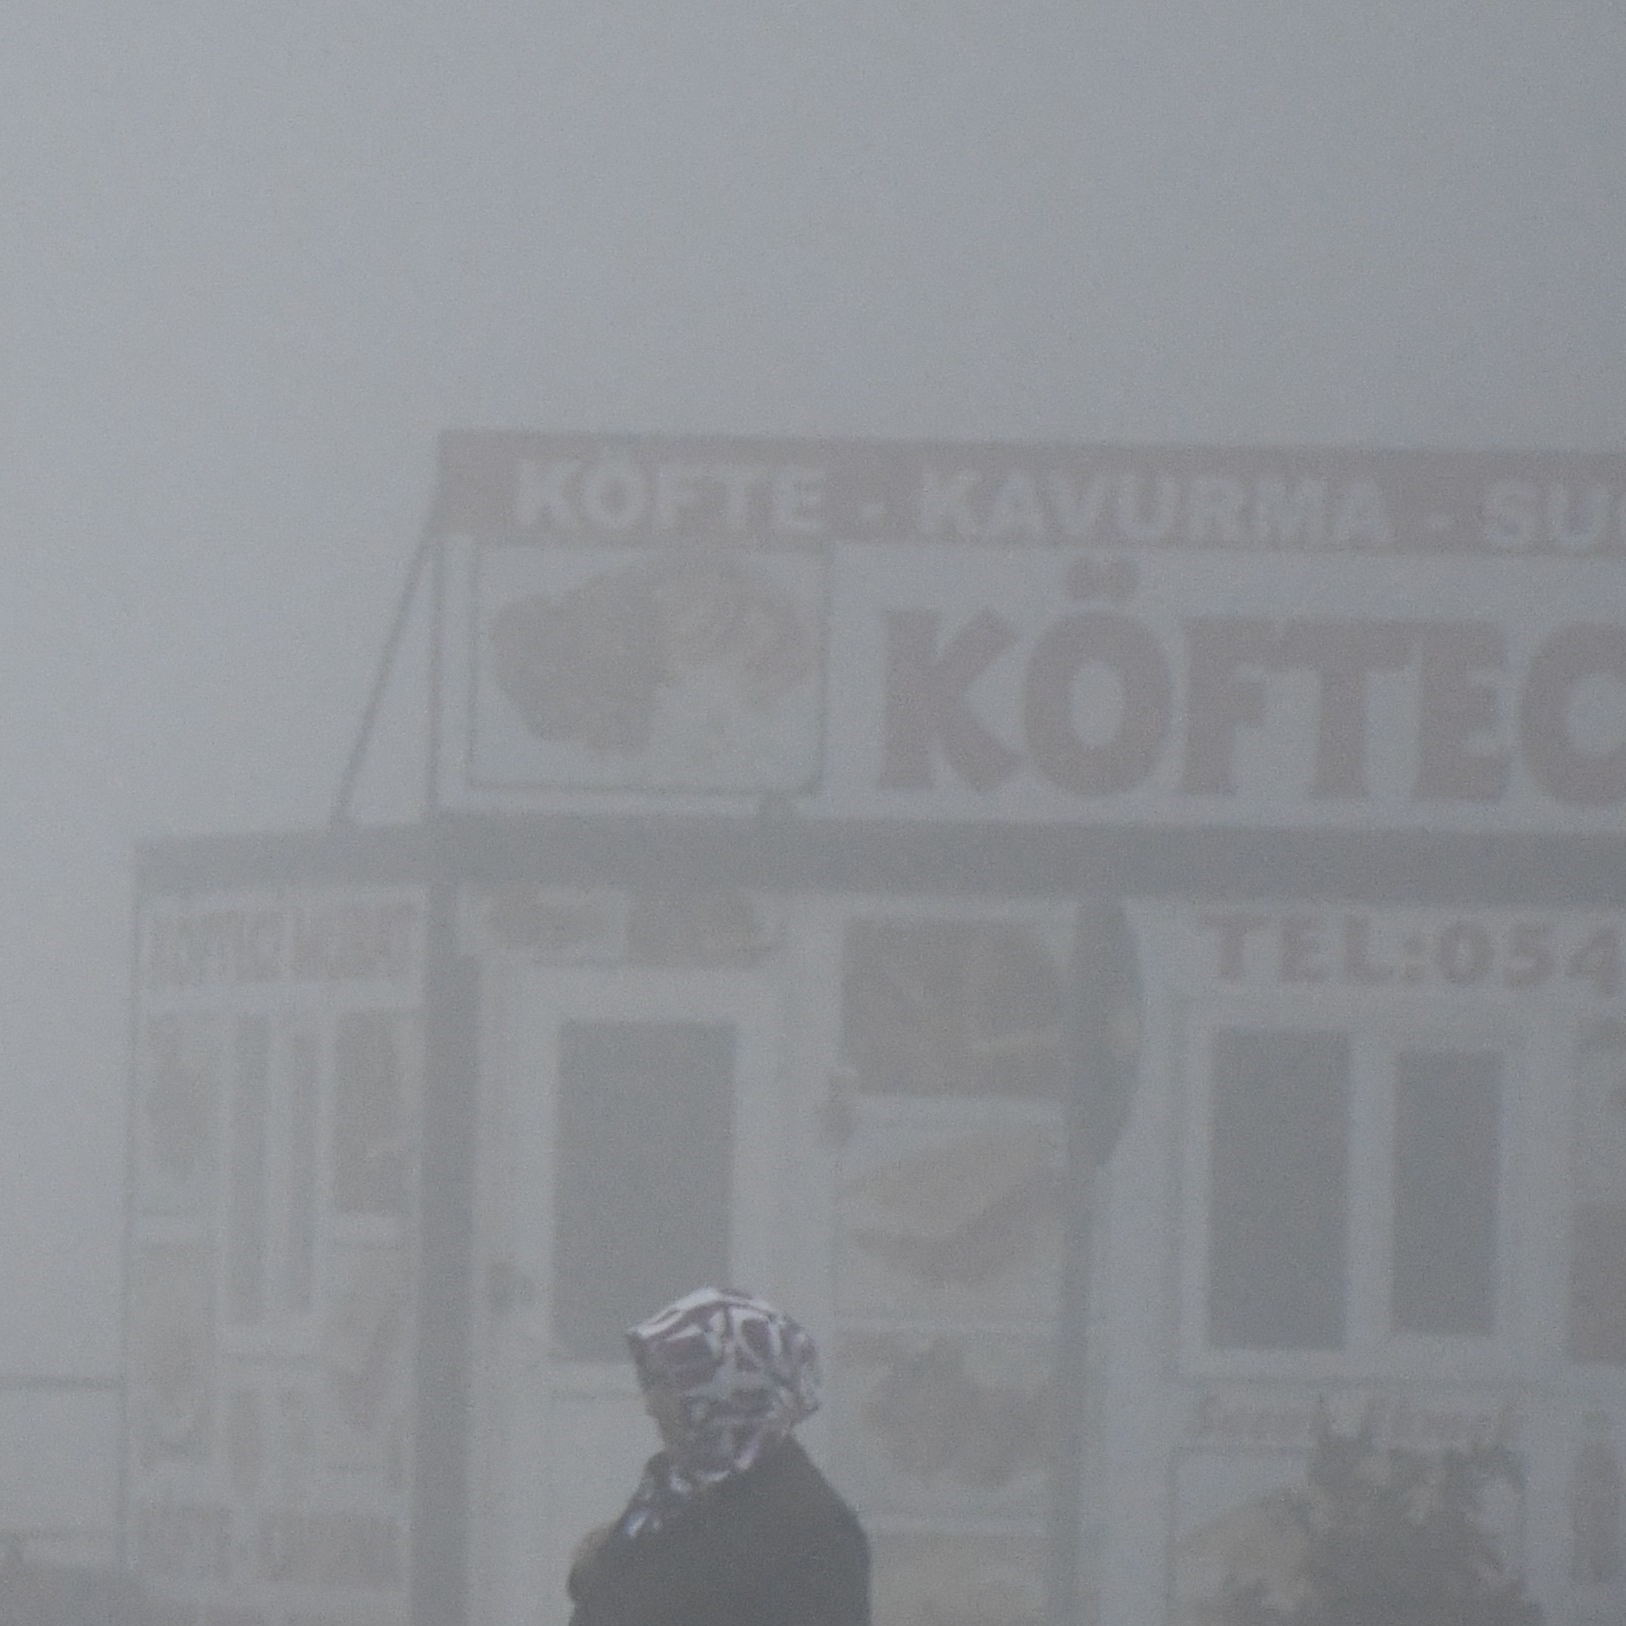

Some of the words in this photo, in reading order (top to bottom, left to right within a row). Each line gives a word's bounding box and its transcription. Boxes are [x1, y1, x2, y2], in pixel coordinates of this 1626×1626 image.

[513, 450, 828, 534] KÖFTE
[917, 467, 1395, 547] KAVURMA
[1482, 477, 1626, 552] SU
